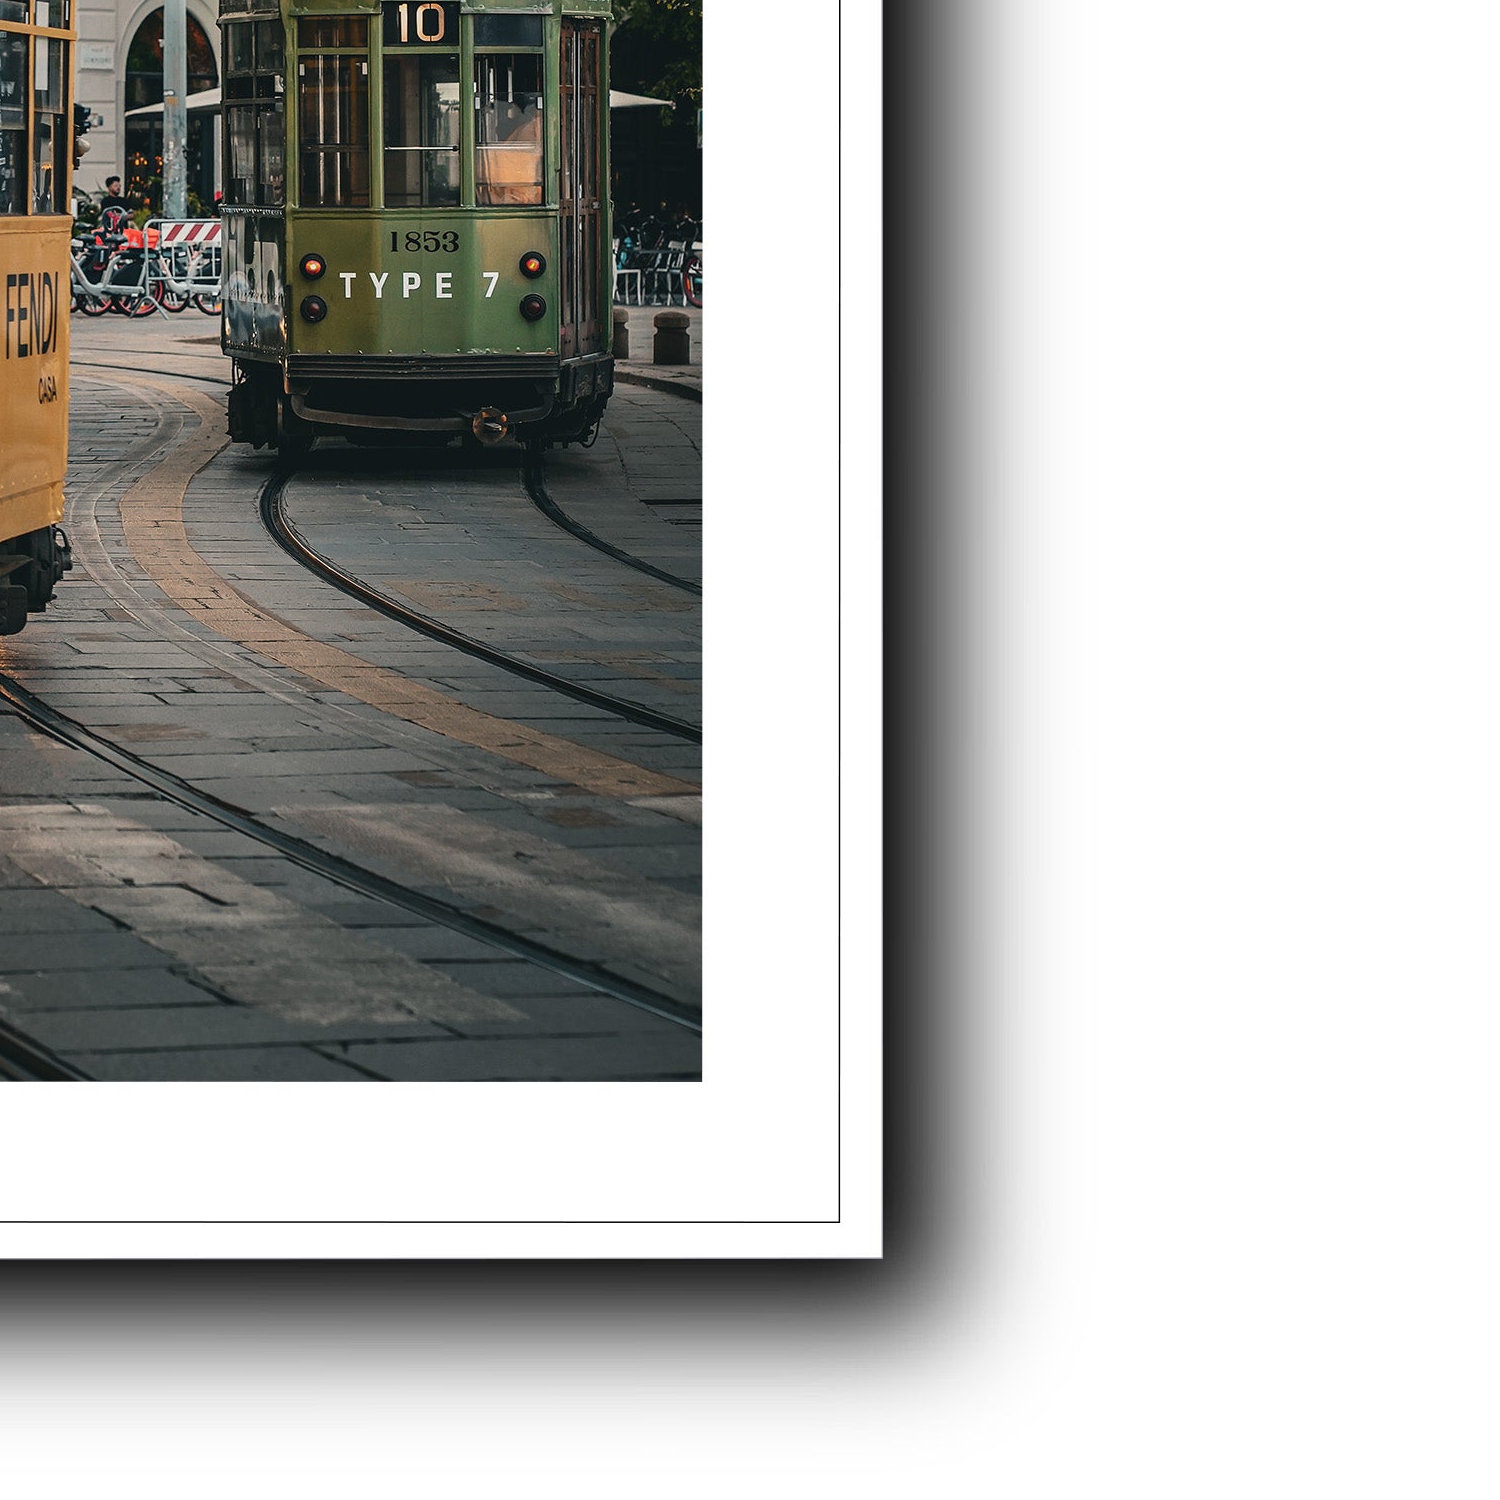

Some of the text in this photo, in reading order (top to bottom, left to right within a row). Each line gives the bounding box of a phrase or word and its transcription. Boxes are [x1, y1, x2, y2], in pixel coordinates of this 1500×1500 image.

[398, 3, 445, 42] 10
[390, 231, 460, 252] 1853
[339, 271, 500, 299] TYPE 7
[6, 271, 58, 360] FENDI
[38, 375, 58, 404] CASA
